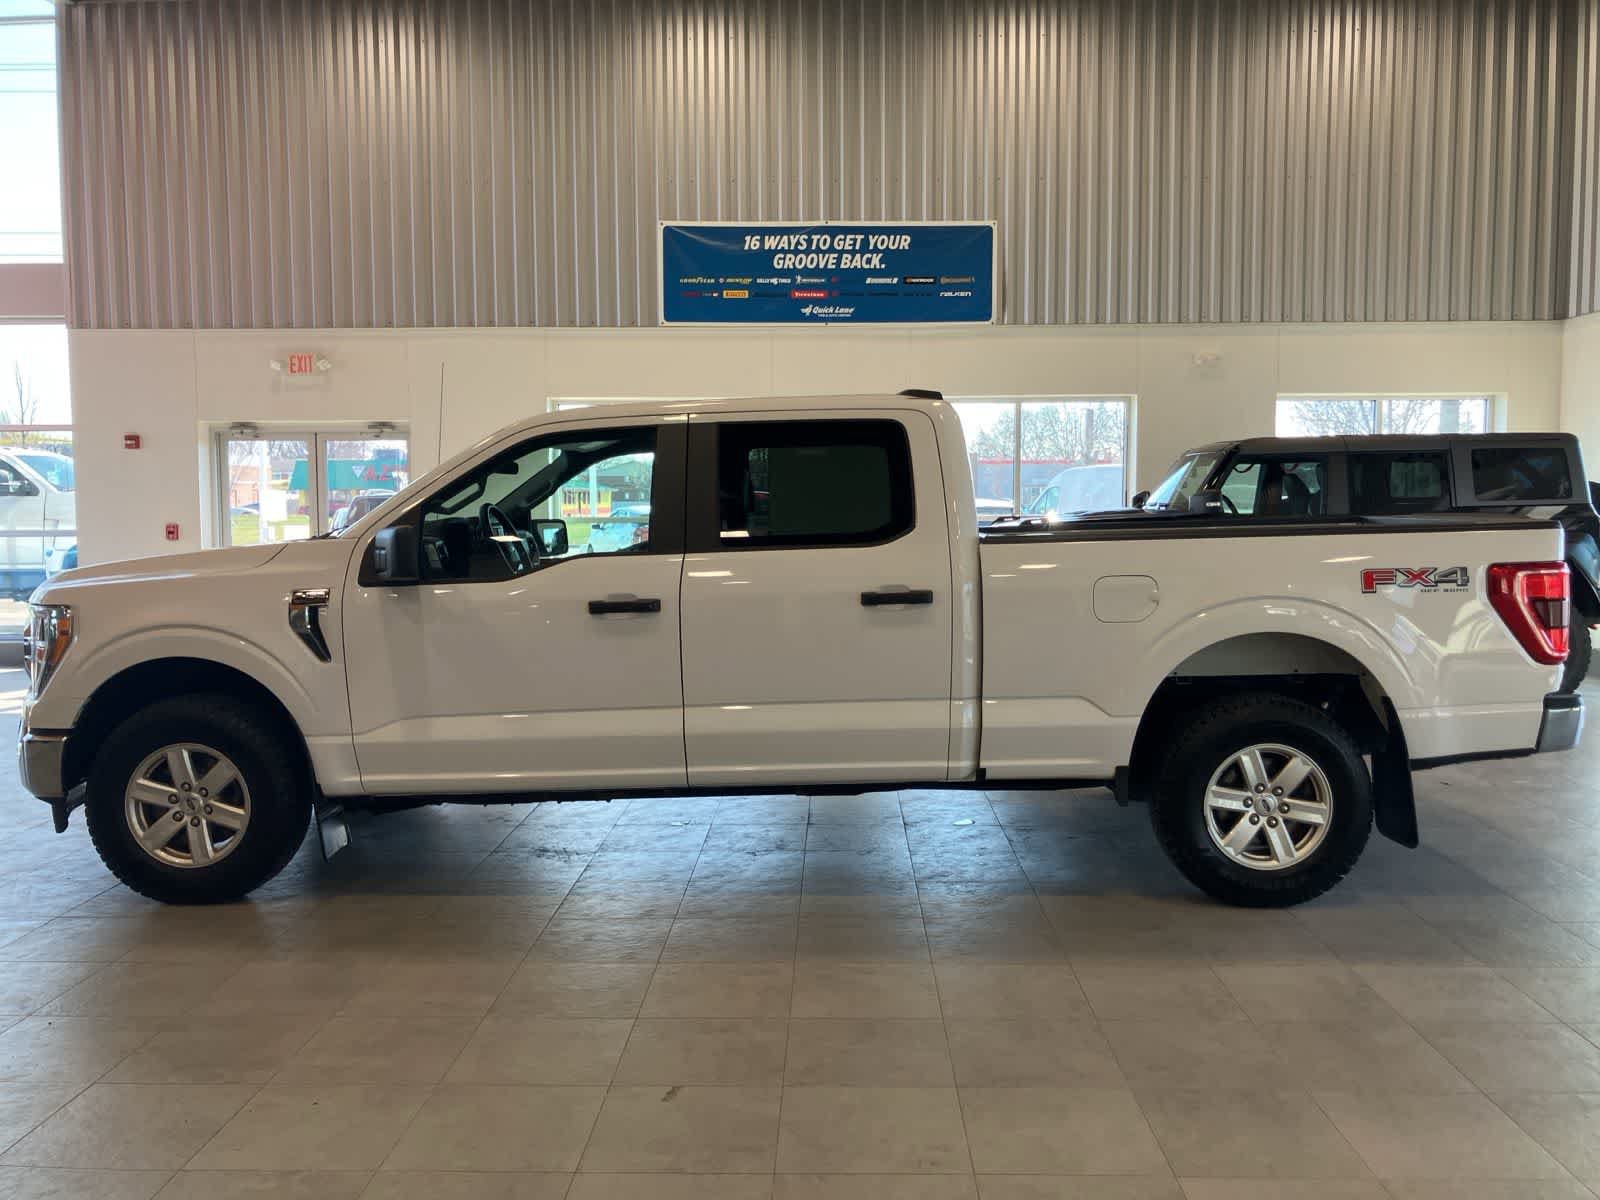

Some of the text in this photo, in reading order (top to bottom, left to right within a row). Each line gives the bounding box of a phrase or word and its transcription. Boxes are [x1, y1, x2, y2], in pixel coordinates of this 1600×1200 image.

[743, 234, 911, 250] 16 WAYS TO GET YOUR
[773, 253, 886, 269] GROOVE BACK.
[812, 306, 855, 314] Quick Lane
[290, 355, 313, 374] EXIT
[1360, 566, 1470, 594] FX4
